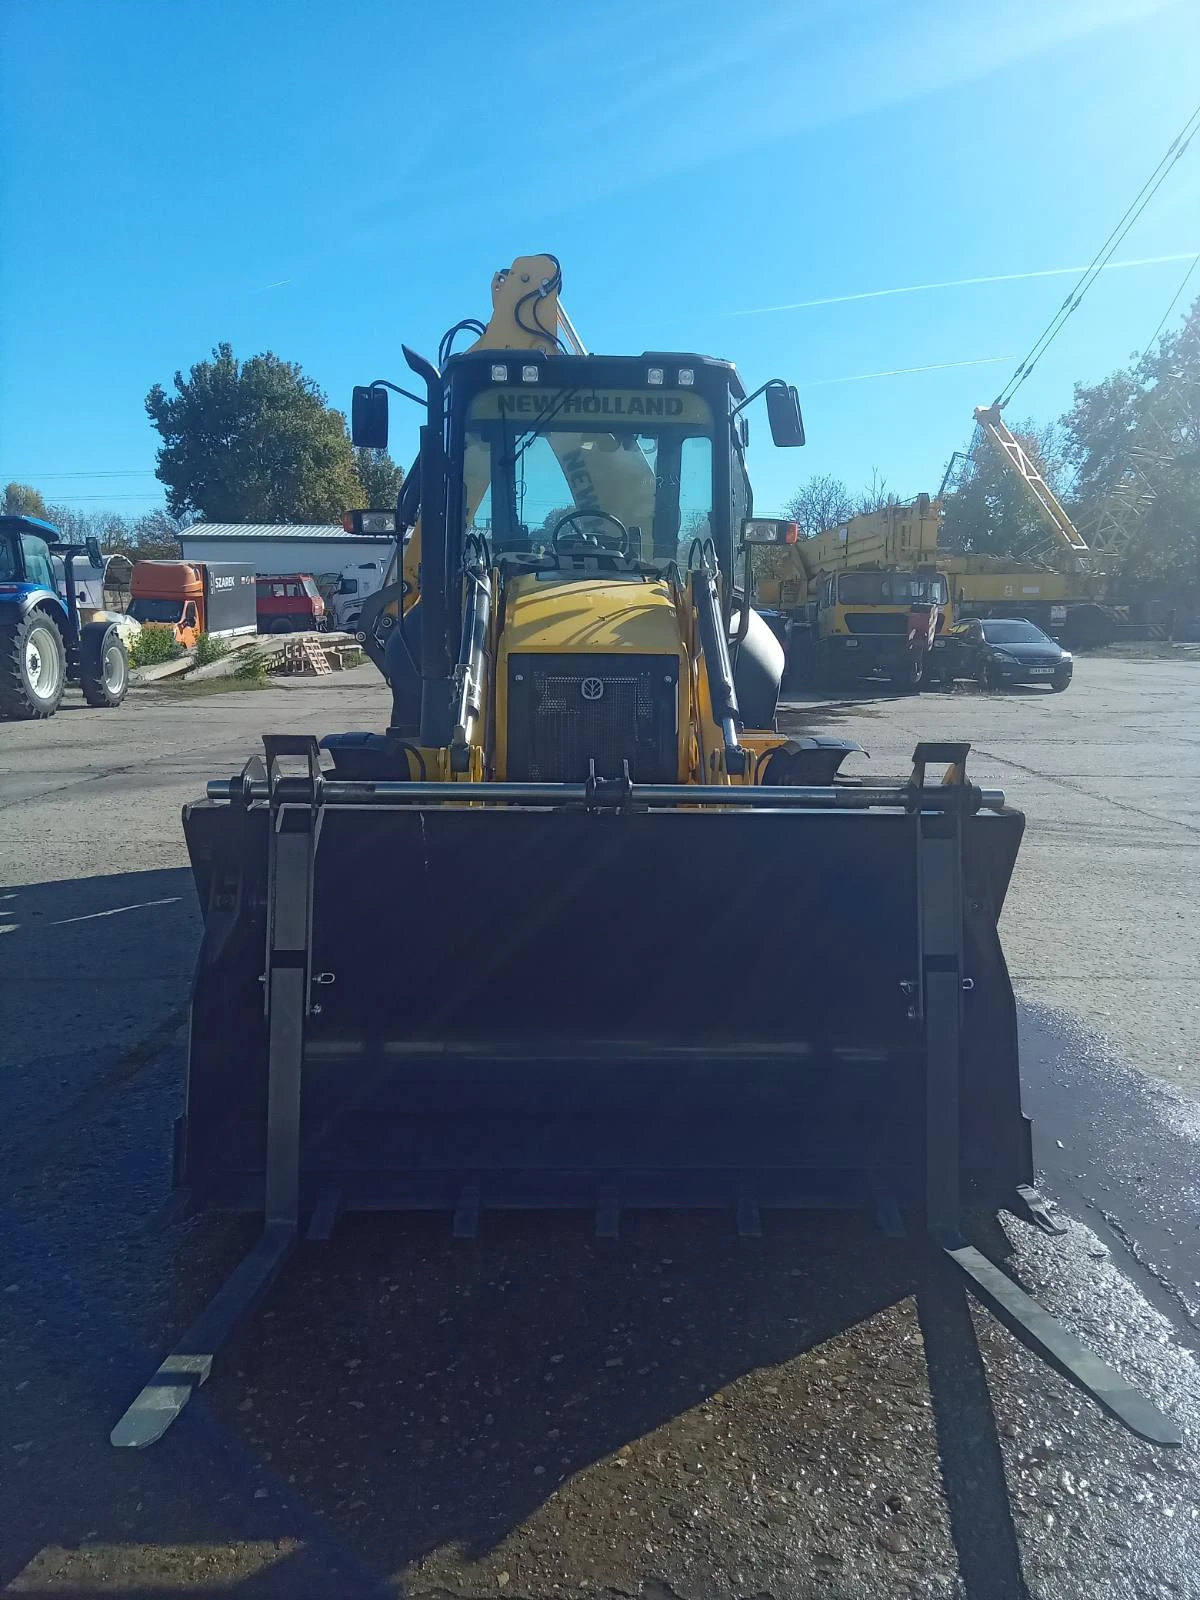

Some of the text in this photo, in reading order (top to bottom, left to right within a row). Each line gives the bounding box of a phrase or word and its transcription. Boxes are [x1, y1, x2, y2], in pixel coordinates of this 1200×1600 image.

[497, 395, 683, 416] NEW HOLLAND
[215, 576, 235, 588] SZAREK
